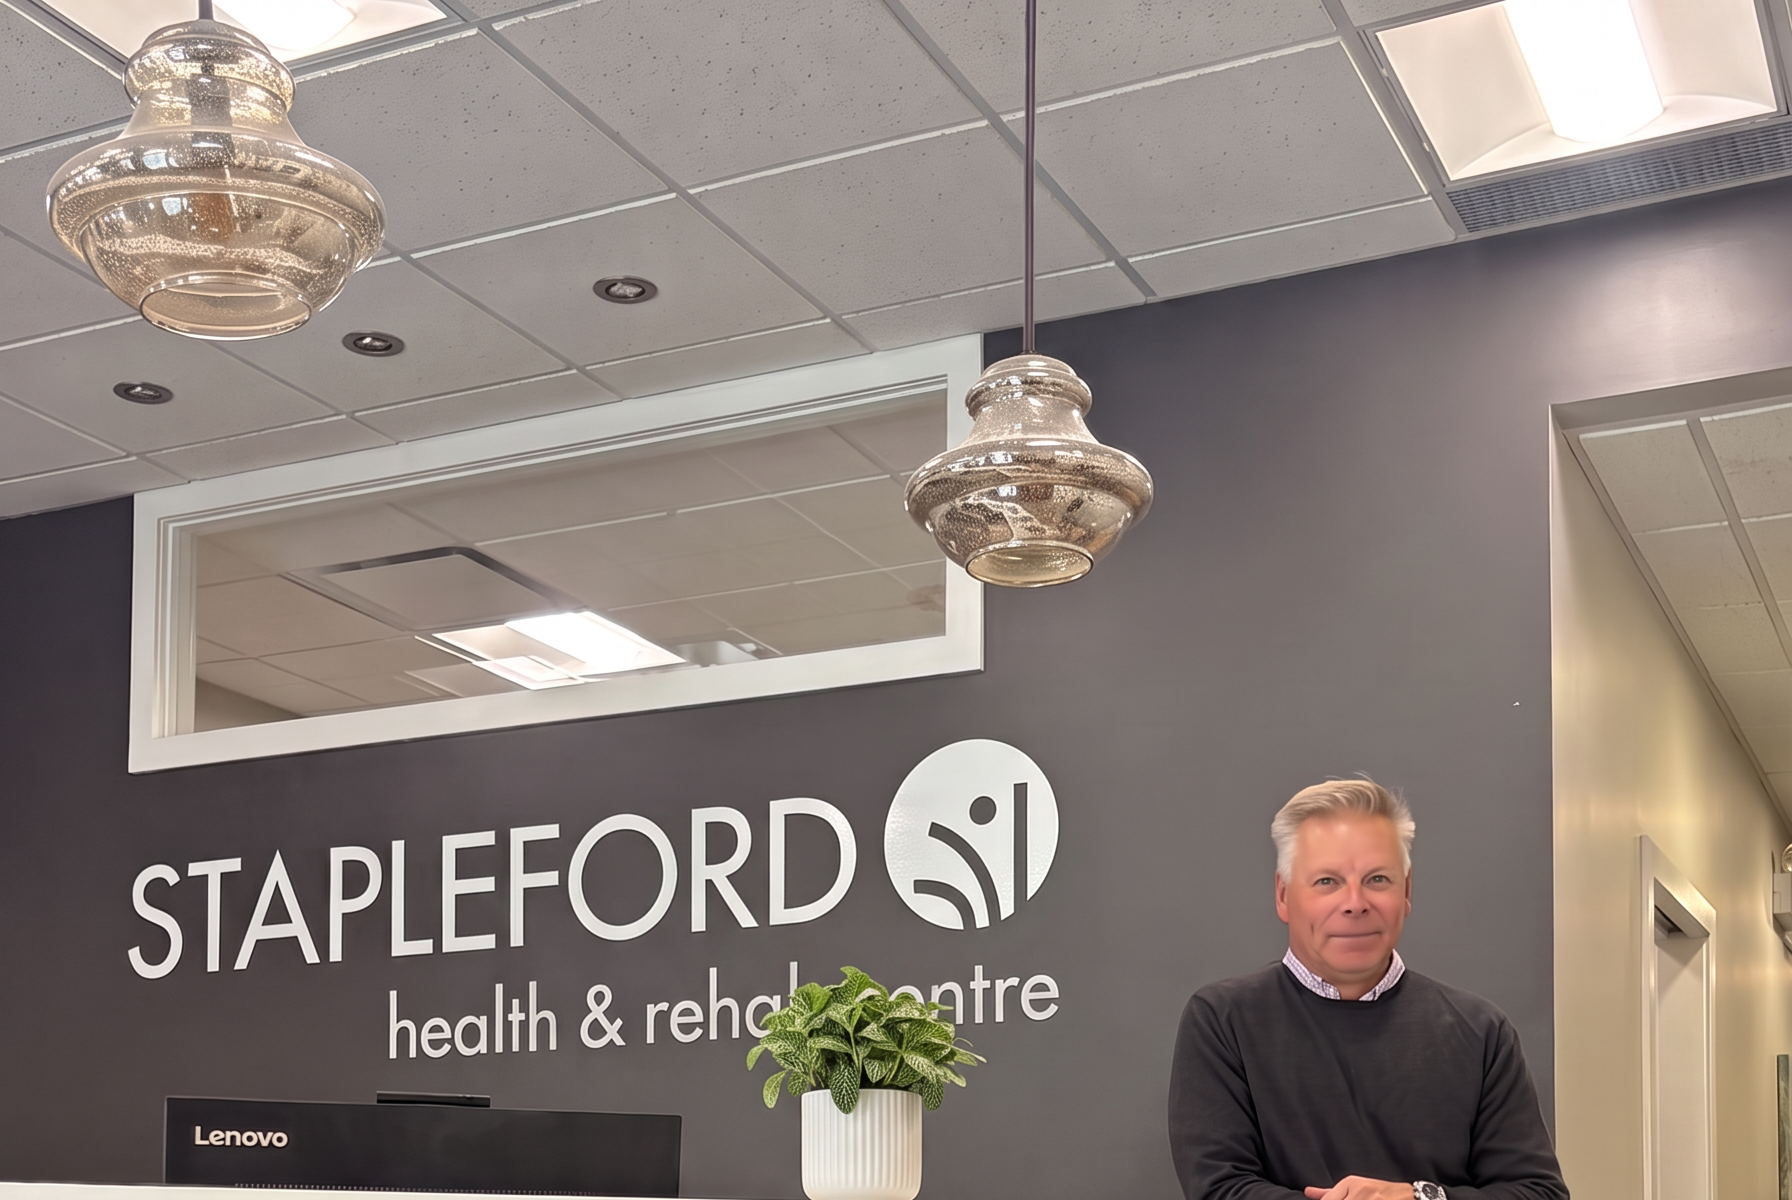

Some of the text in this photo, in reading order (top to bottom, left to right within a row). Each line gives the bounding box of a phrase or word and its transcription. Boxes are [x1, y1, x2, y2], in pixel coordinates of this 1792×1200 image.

[127, 796, 858, 980] STAPLEFORD
[388, 981, 558, 1059] health
[579, 984, 626, 1050] &
[193, 1124, 289, 1148] Lenovo
